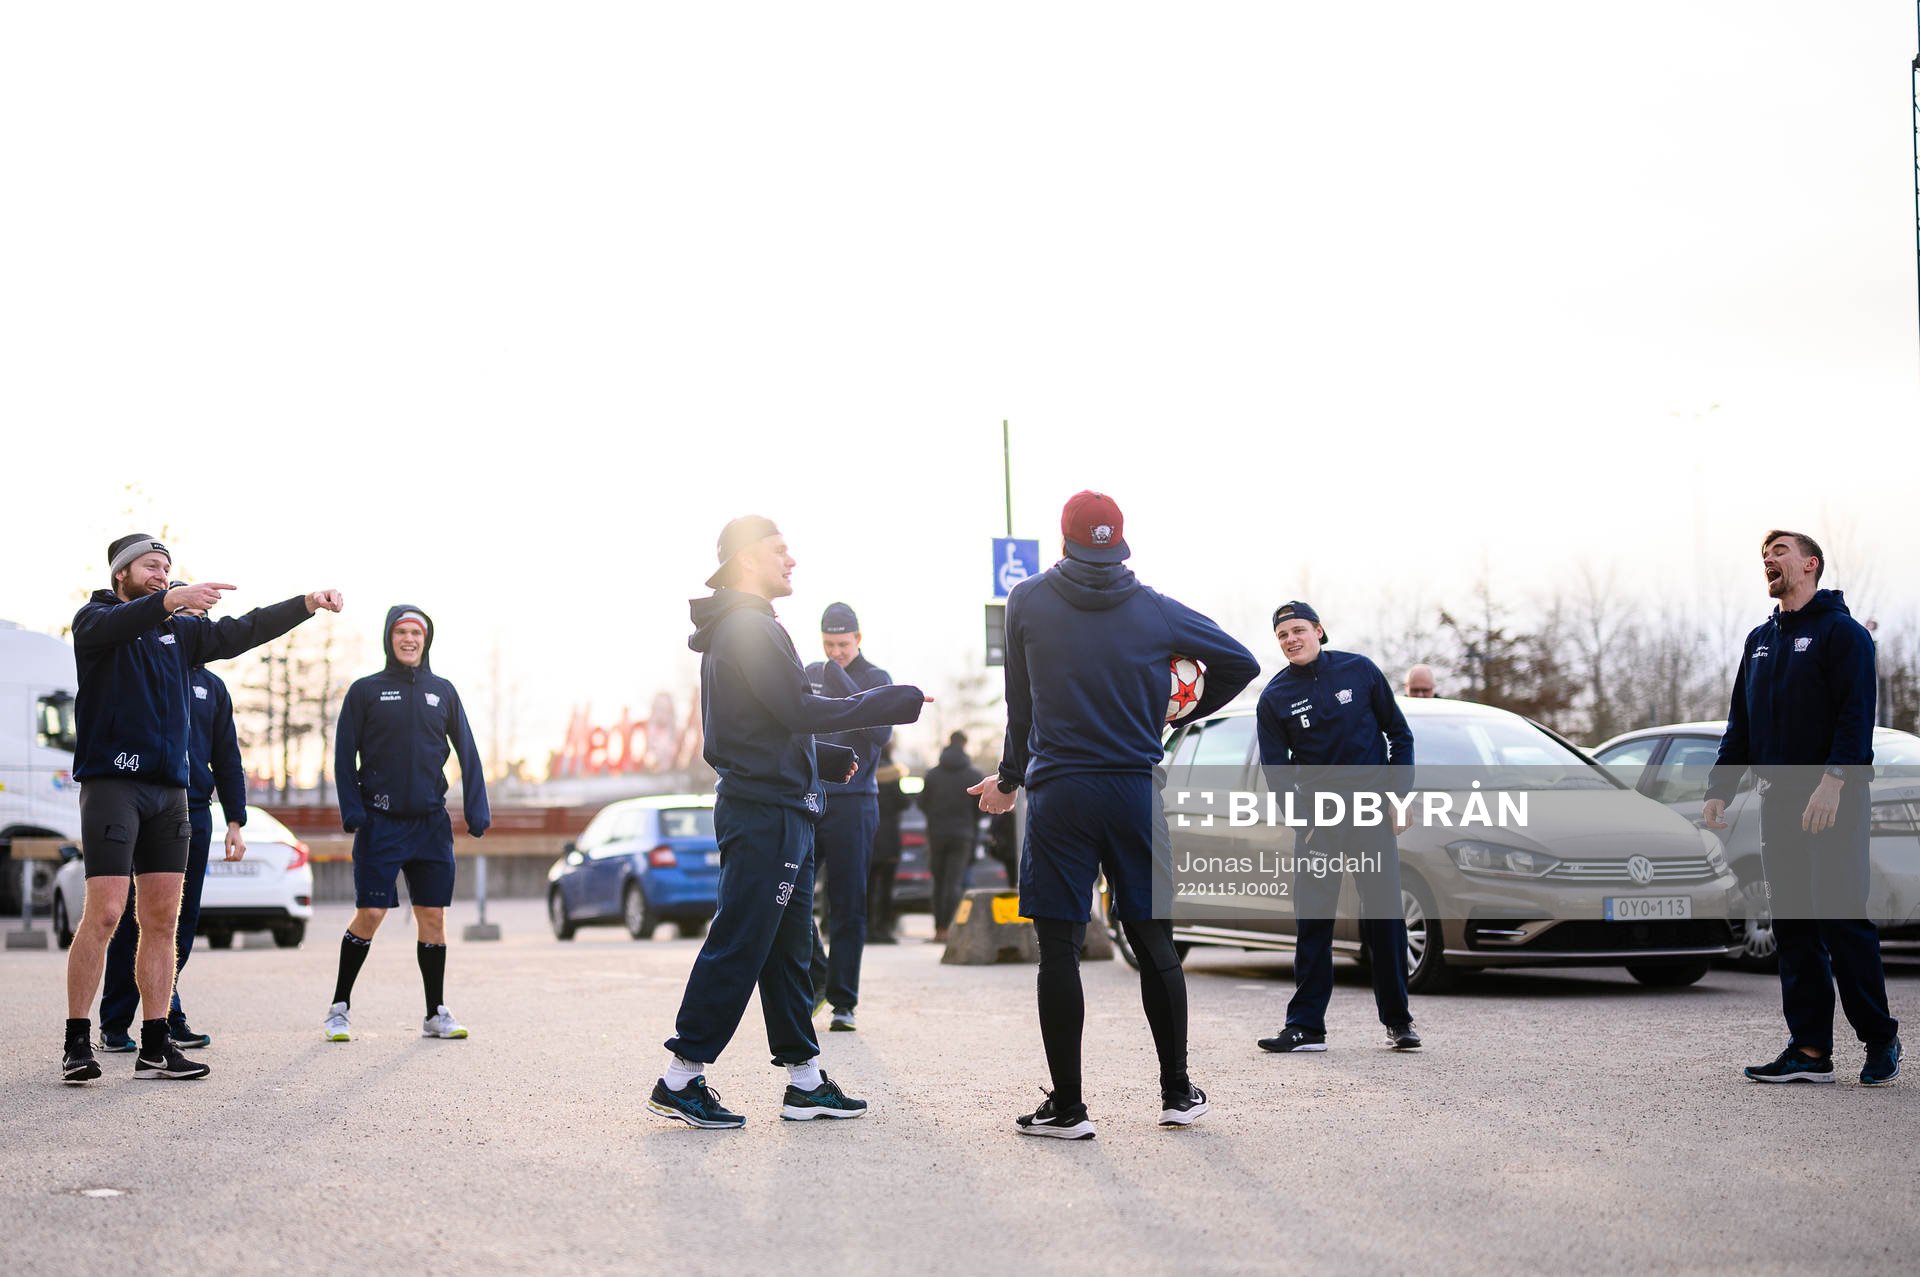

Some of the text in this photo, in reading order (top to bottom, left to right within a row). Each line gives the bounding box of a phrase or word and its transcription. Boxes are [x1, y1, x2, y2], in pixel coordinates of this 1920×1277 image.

[1300, 714, 1310, 728] 6
[114, 752, 139, 772] 44
[1657, 900, 1685, 916] 113
